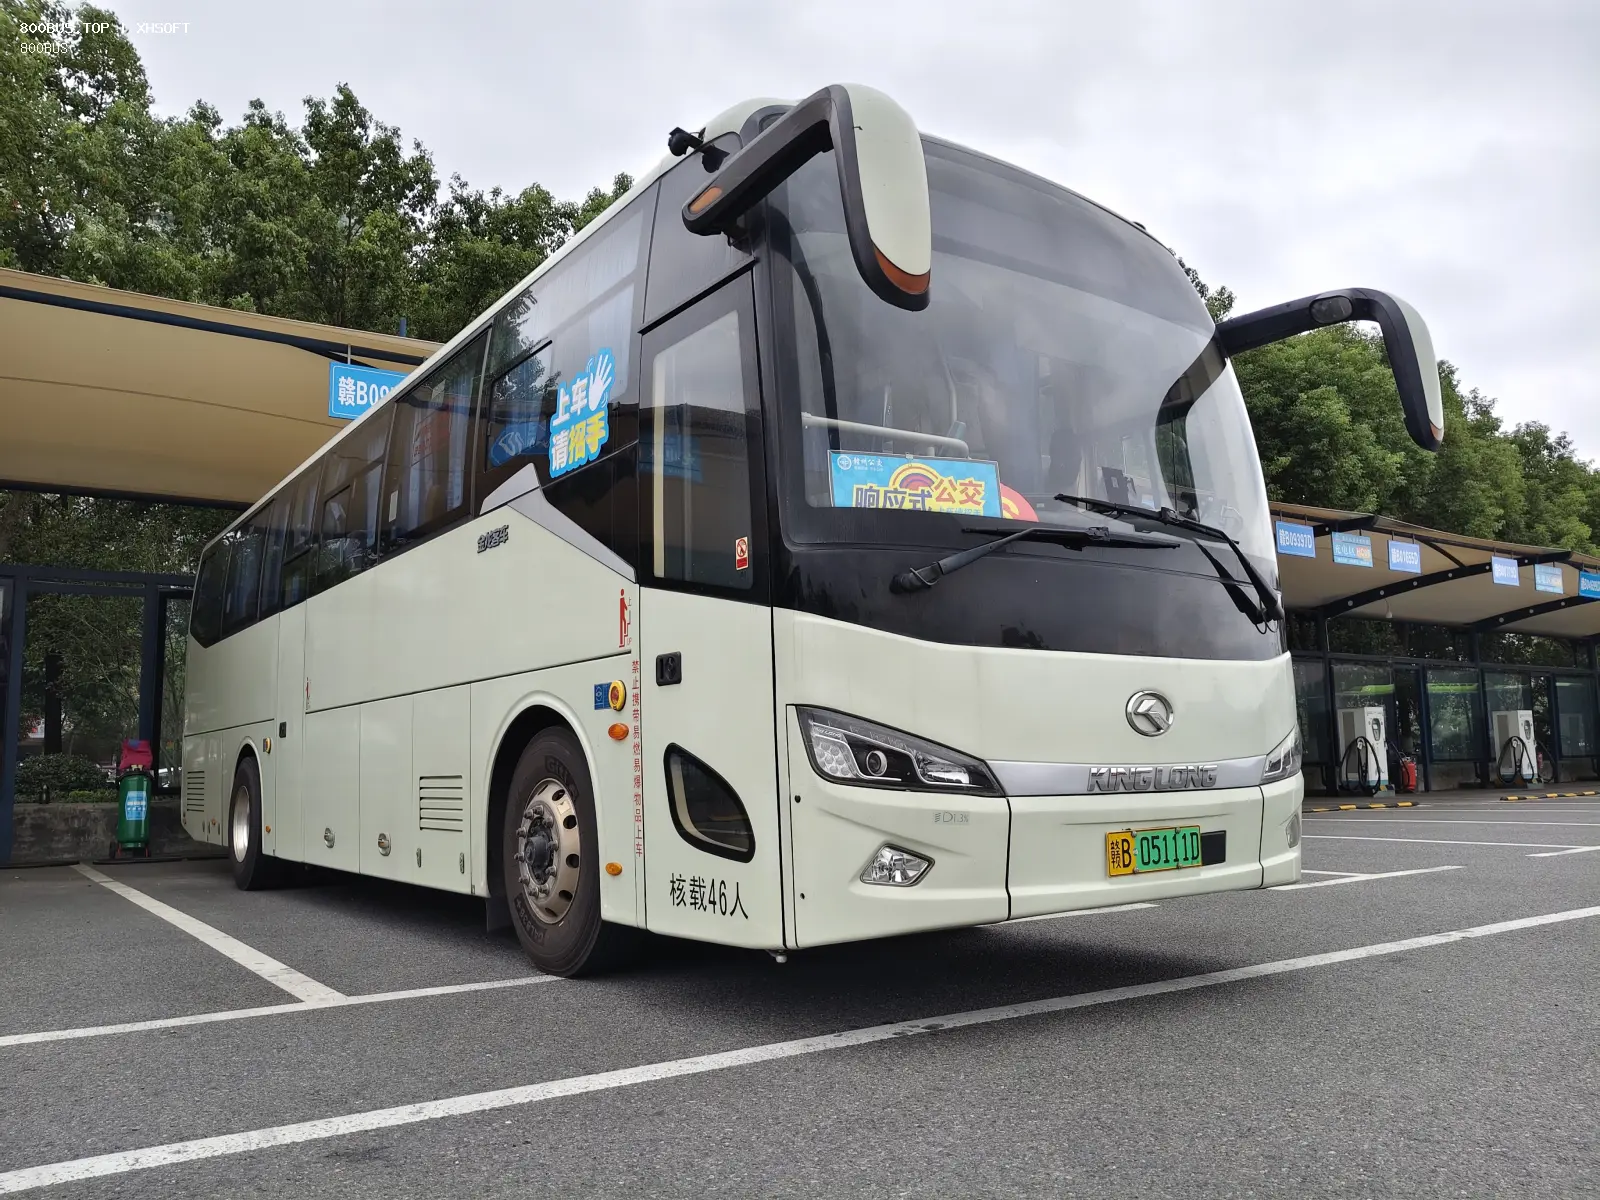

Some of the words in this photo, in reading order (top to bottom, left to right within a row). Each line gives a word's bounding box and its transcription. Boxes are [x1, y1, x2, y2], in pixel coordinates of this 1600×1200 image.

[552, 376, 588, 427] 上车
[551, 410, 606, 472] 请招手
[1086, 767, 1153, 792] KING
[1153, 764, 1218, 790] LONG
[669, 872, 749, 920] 核载46人
